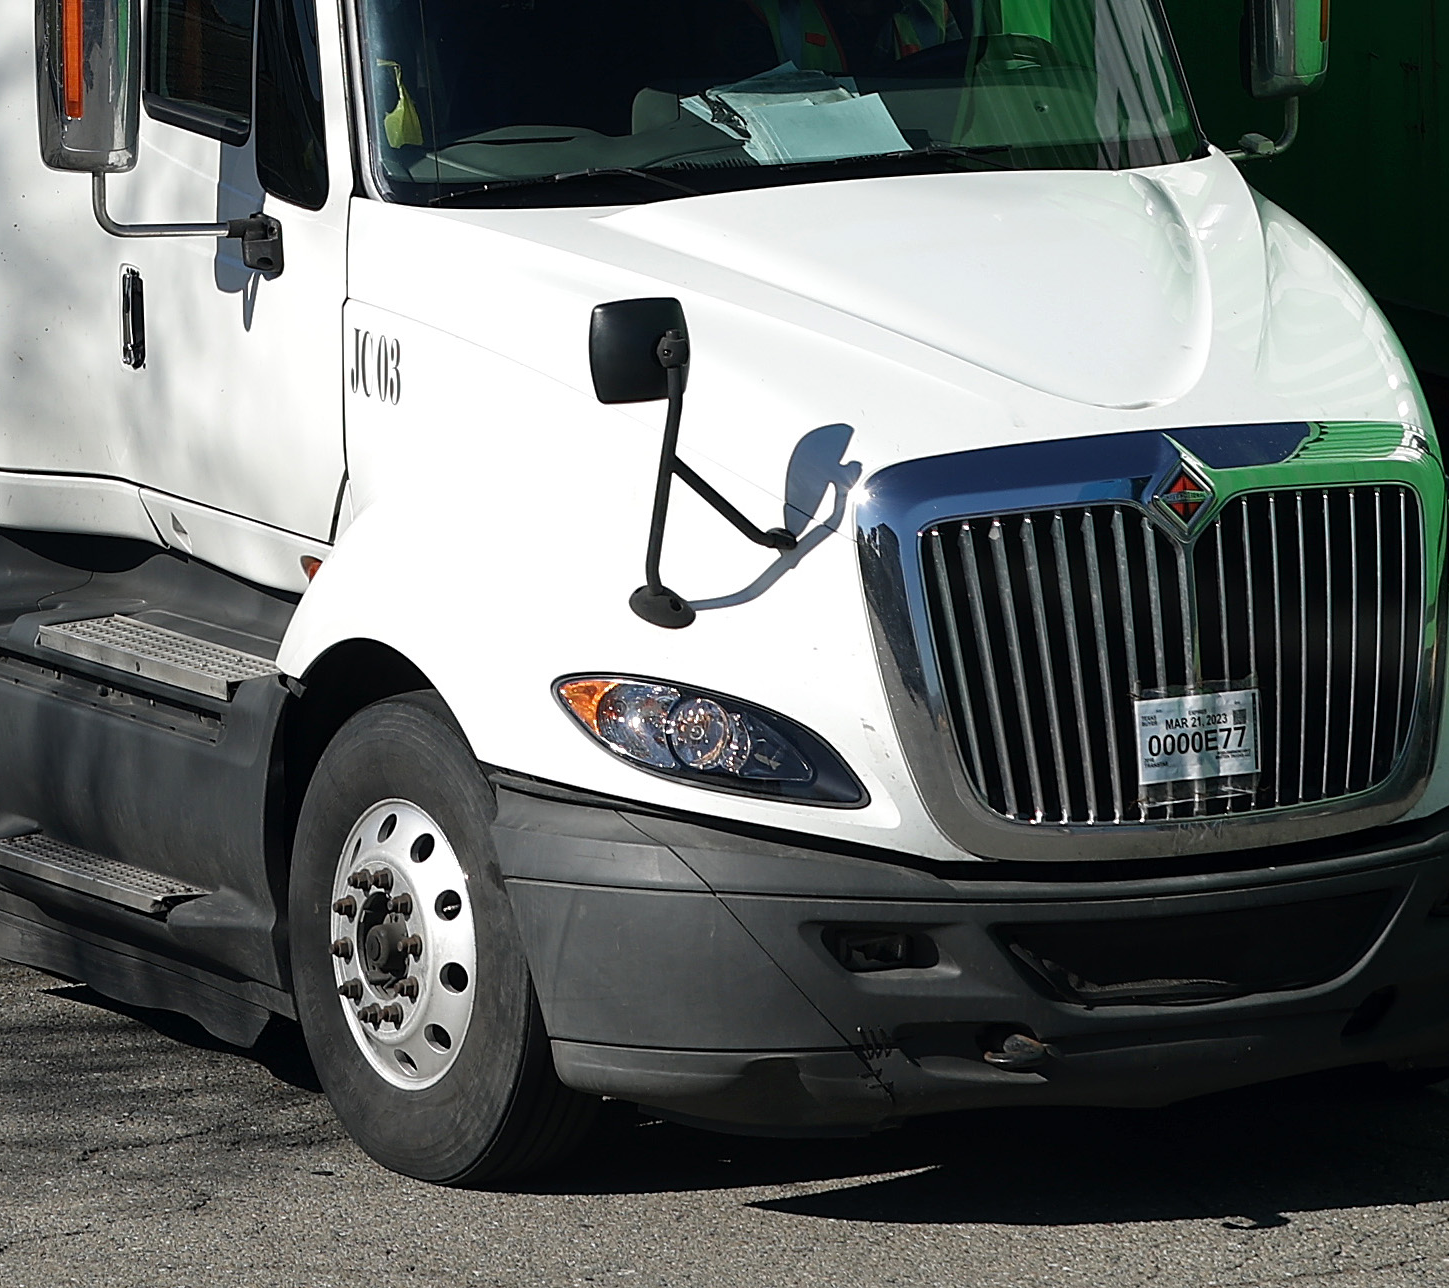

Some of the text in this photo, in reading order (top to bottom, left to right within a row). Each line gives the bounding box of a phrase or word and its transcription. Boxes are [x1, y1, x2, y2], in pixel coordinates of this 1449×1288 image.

[350, 326, 403, 407] JC 03
[1165, 718, 1188, 730] MAR
[1206, 713, 1228, 726] 2023
[1148, 725, 1247, 757] 0000E77
